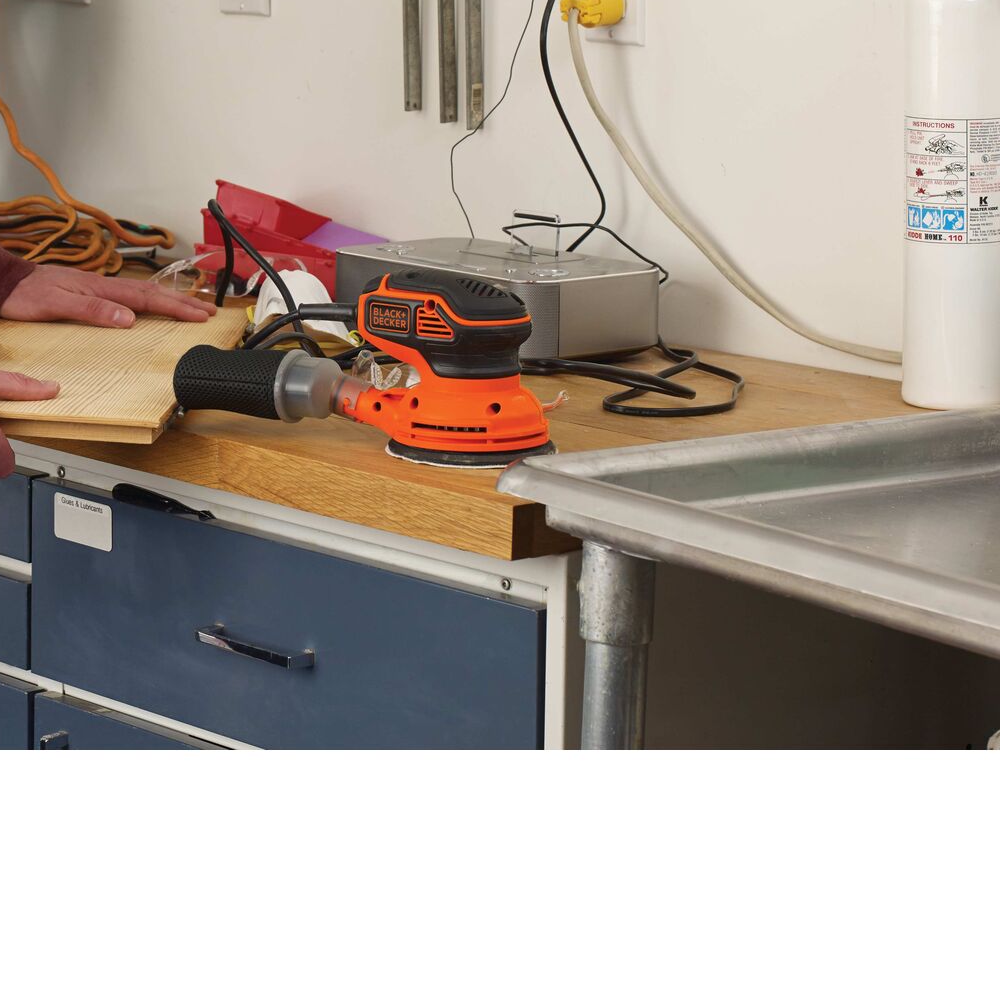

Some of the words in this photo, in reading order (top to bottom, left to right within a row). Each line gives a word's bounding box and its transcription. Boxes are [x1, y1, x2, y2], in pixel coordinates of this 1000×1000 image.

[912, 121, 955, 129] INSTRUCTIONS
[373, 308, 407, 318] BLACK+
[373, 316, 406, 328] DECKER
[80, 503, 103, 513] Lubricants
